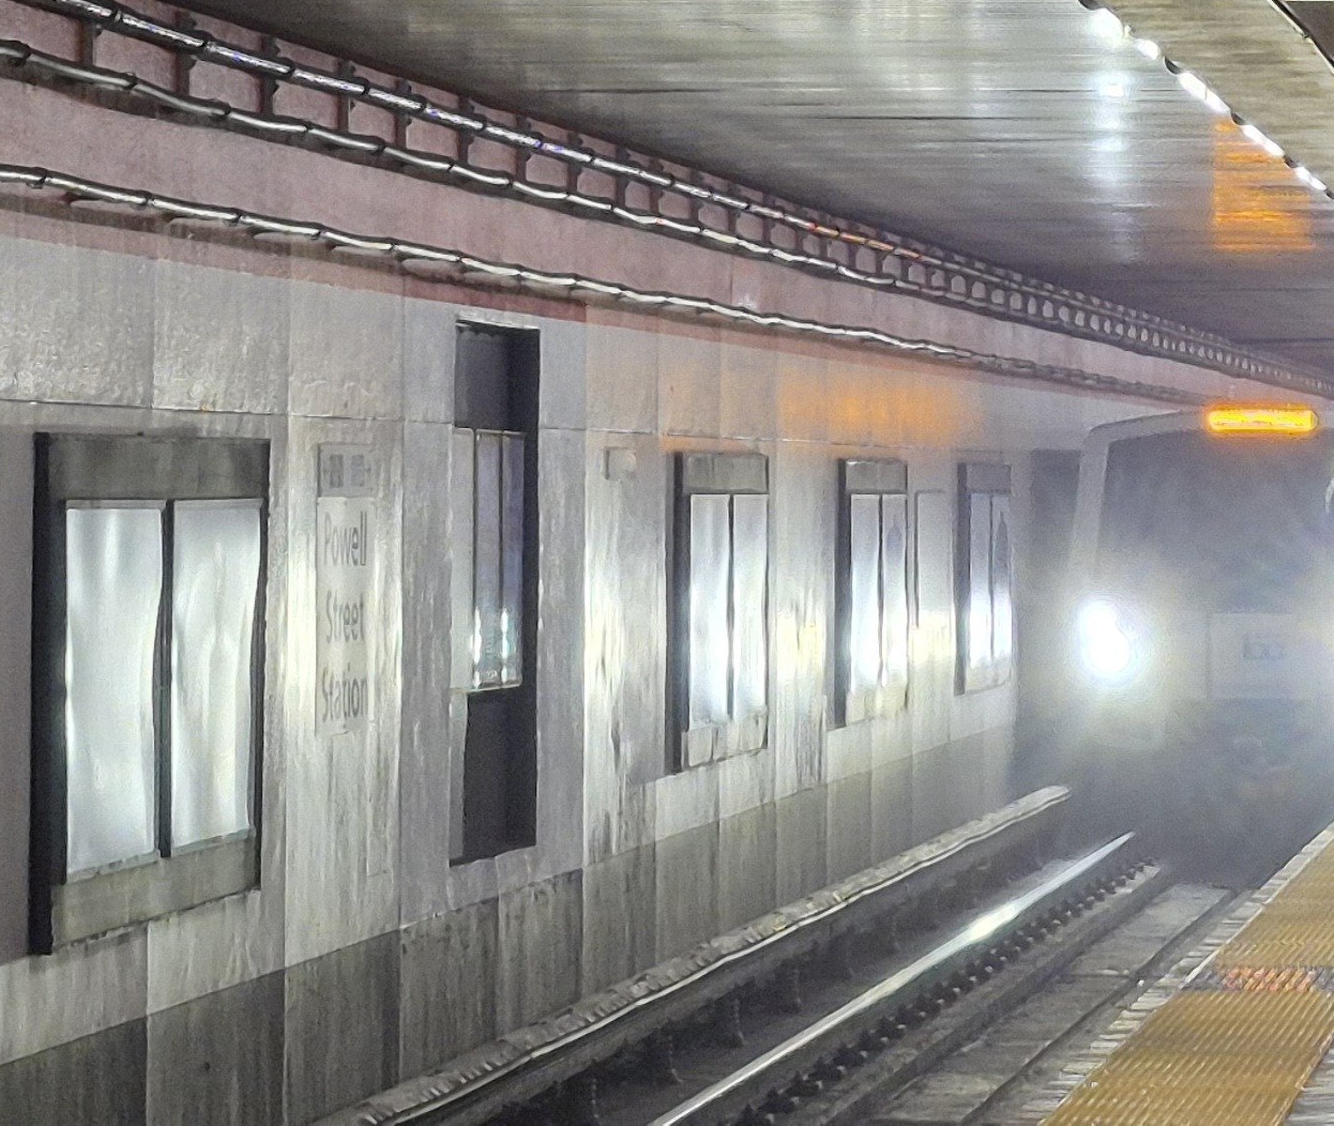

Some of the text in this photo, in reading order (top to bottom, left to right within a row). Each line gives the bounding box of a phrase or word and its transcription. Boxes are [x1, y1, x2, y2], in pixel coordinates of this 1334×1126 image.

[323, 510, 367, 566] Powell
[325, 590, 365, 644] Street
[322, 661, 368, 723] Station
